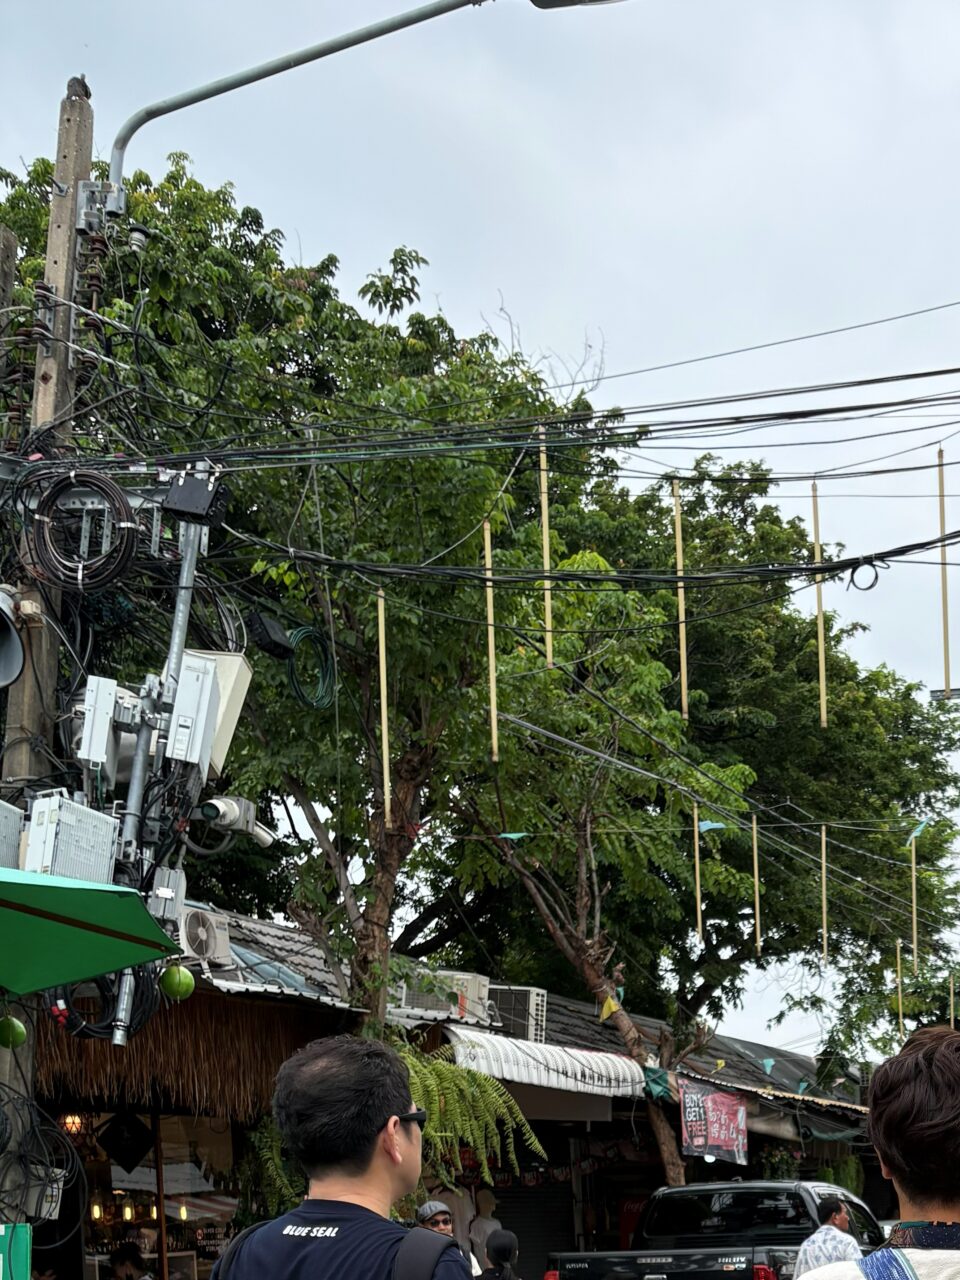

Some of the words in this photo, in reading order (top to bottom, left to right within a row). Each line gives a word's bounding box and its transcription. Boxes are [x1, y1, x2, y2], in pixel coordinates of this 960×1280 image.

[686, 1107, 699, 1121] GET
[687, 1121, 707, 1137] FREE
[282, 1225, 311, 1237] BLUE
[310, 1226, 339, 1237] SEAL
